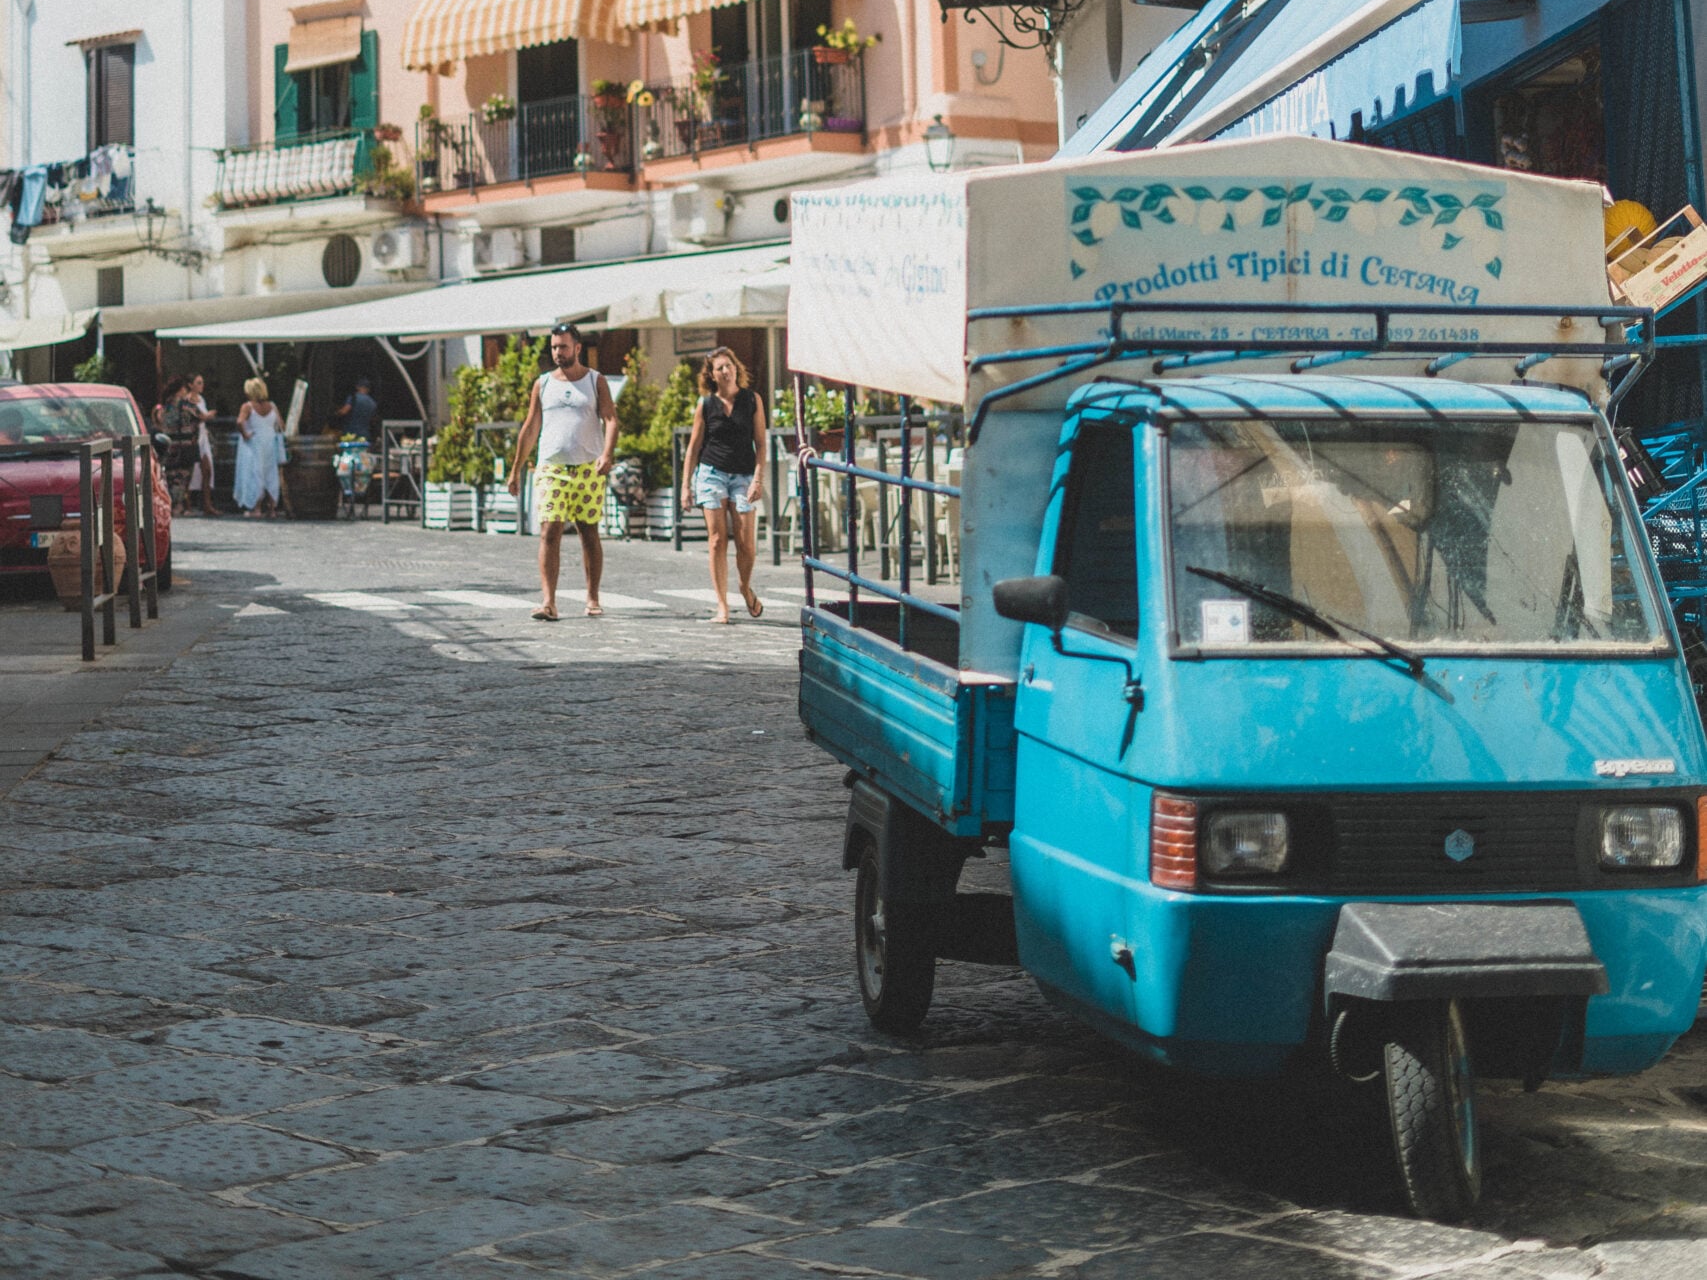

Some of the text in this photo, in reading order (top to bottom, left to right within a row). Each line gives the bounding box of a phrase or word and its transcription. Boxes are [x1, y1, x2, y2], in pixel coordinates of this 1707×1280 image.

[1094, 250, 1480, 305] Prodotti Tipici di CETARA
[1097, 327, 1128, 341] Va
[1133, 326, 1154, 340] del
[1252, 326, 1329, 341] CETARA
